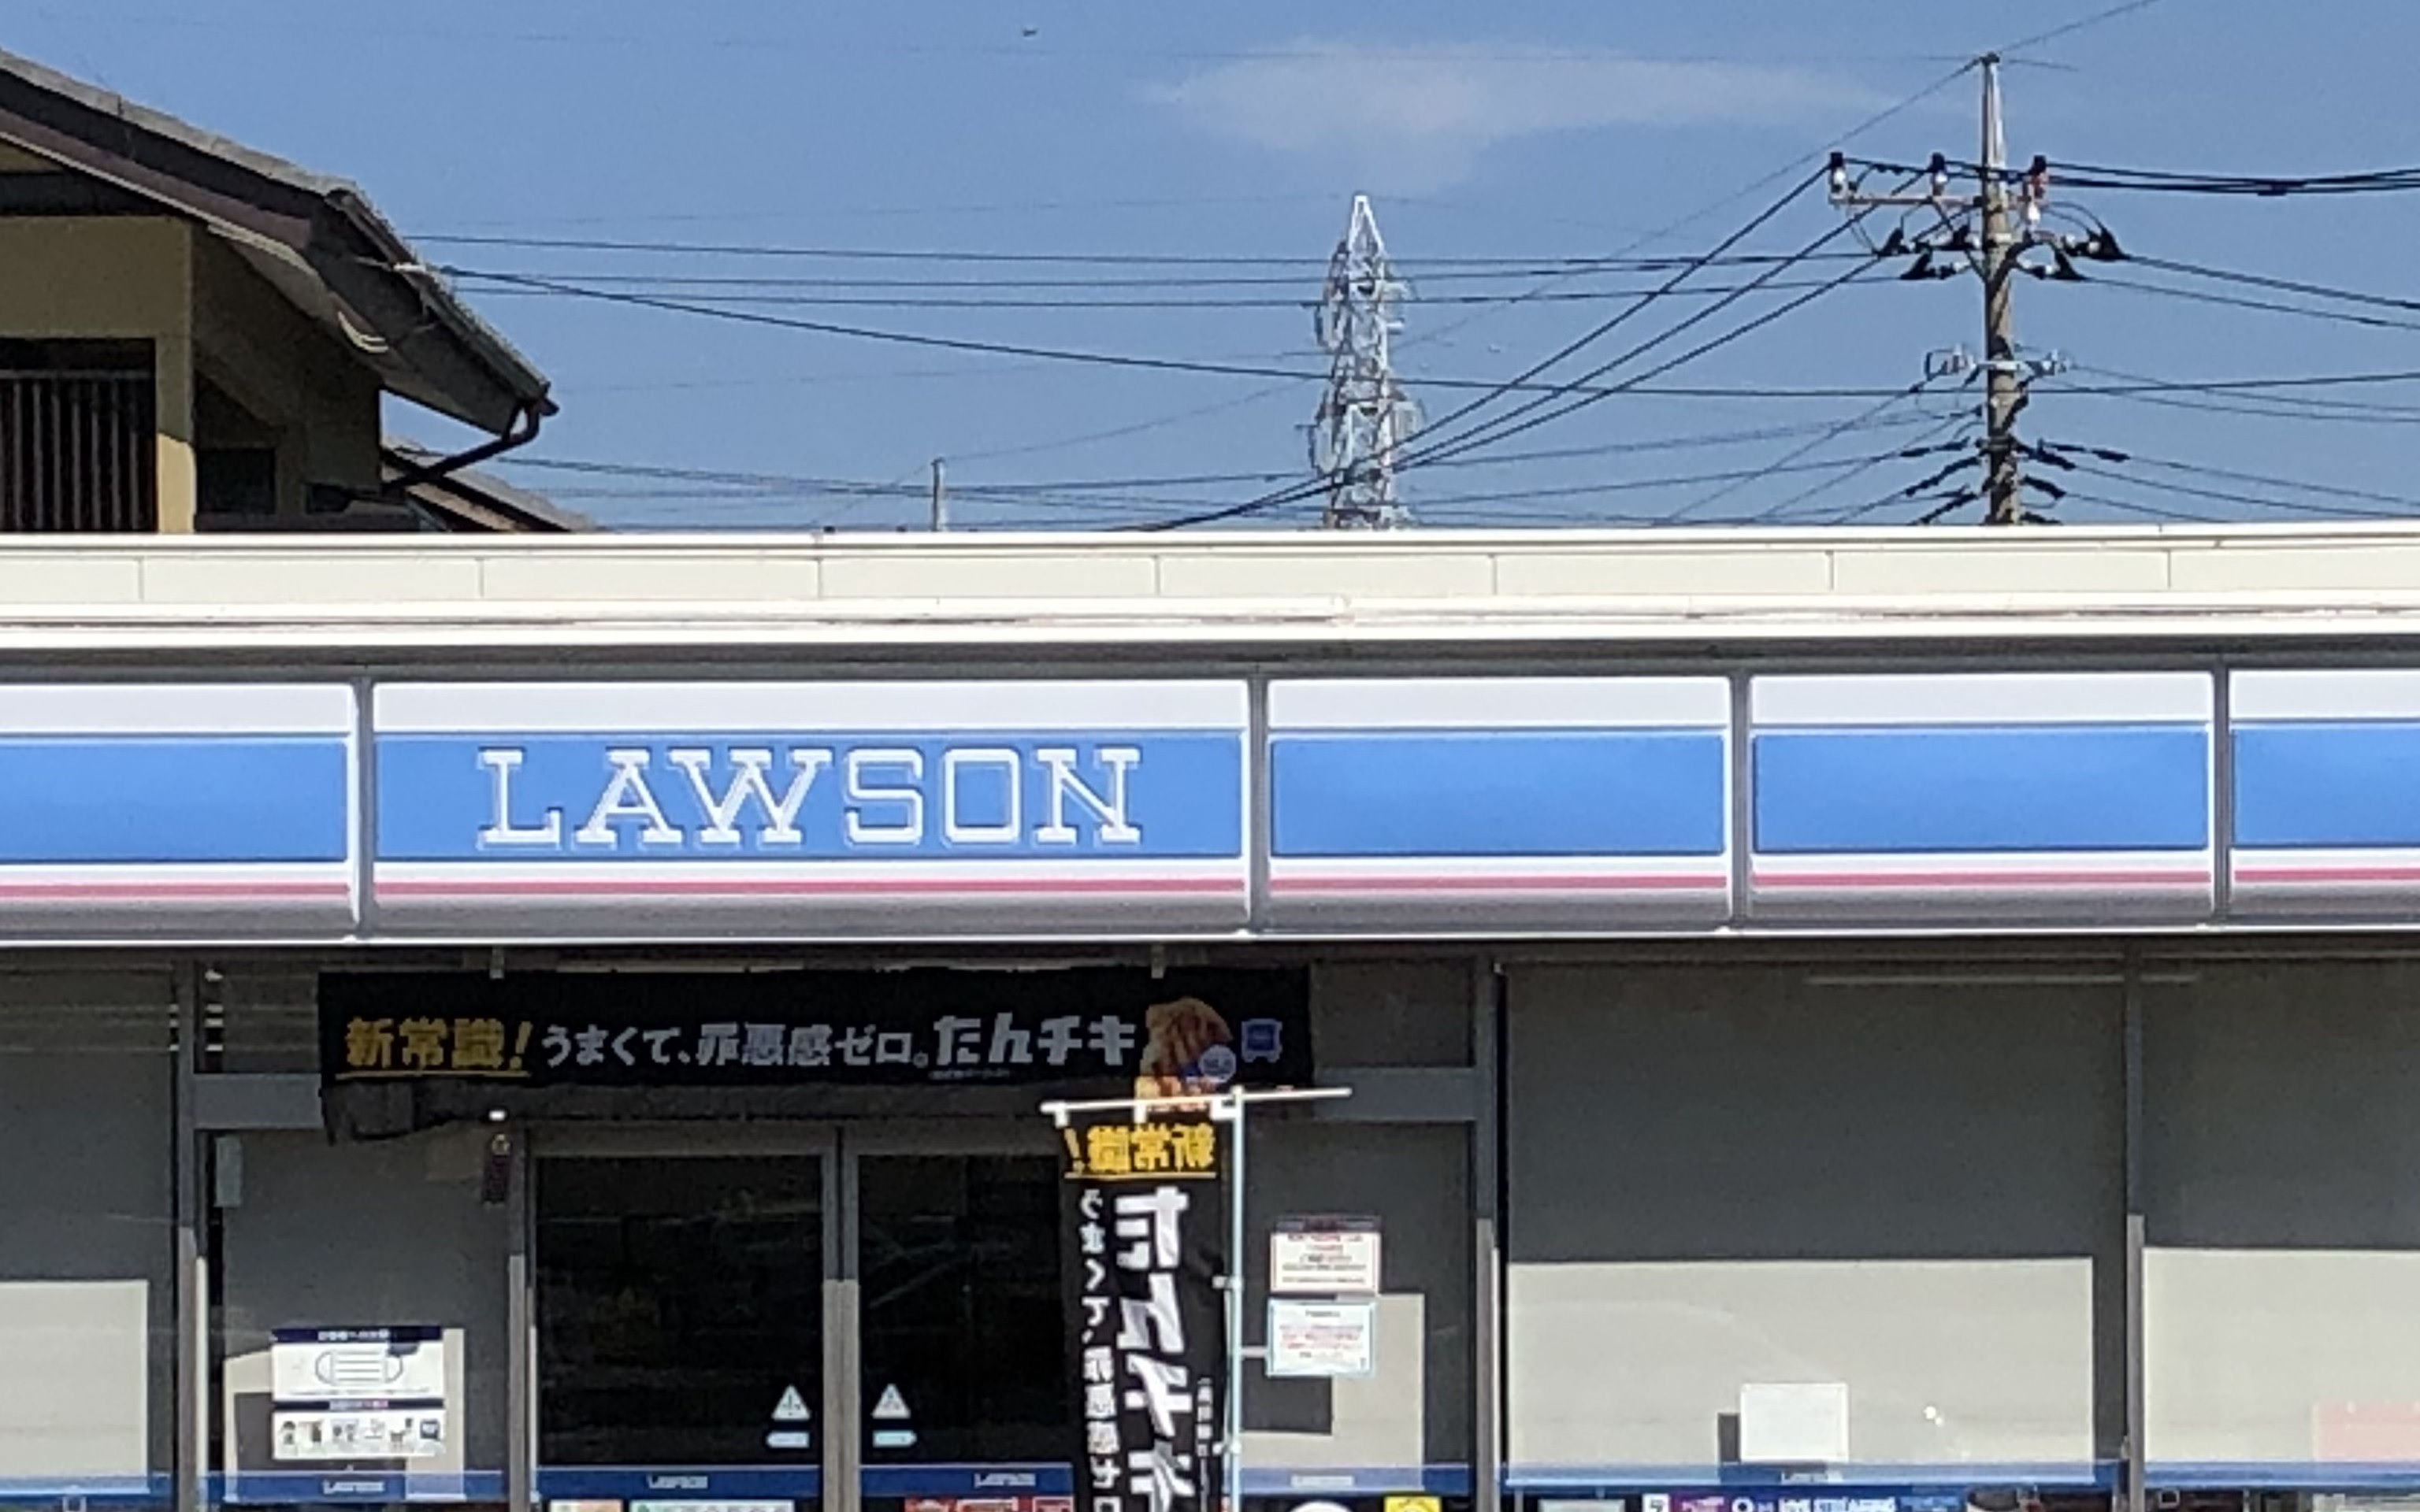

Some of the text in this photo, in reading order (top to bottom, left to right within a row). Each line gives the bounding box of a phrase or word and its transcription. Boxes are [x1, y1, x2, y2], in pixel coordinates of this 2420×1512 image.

[477, 747, 1141, 847] LAWSON
[933, 1012, 1136, 1066] たんチキ
